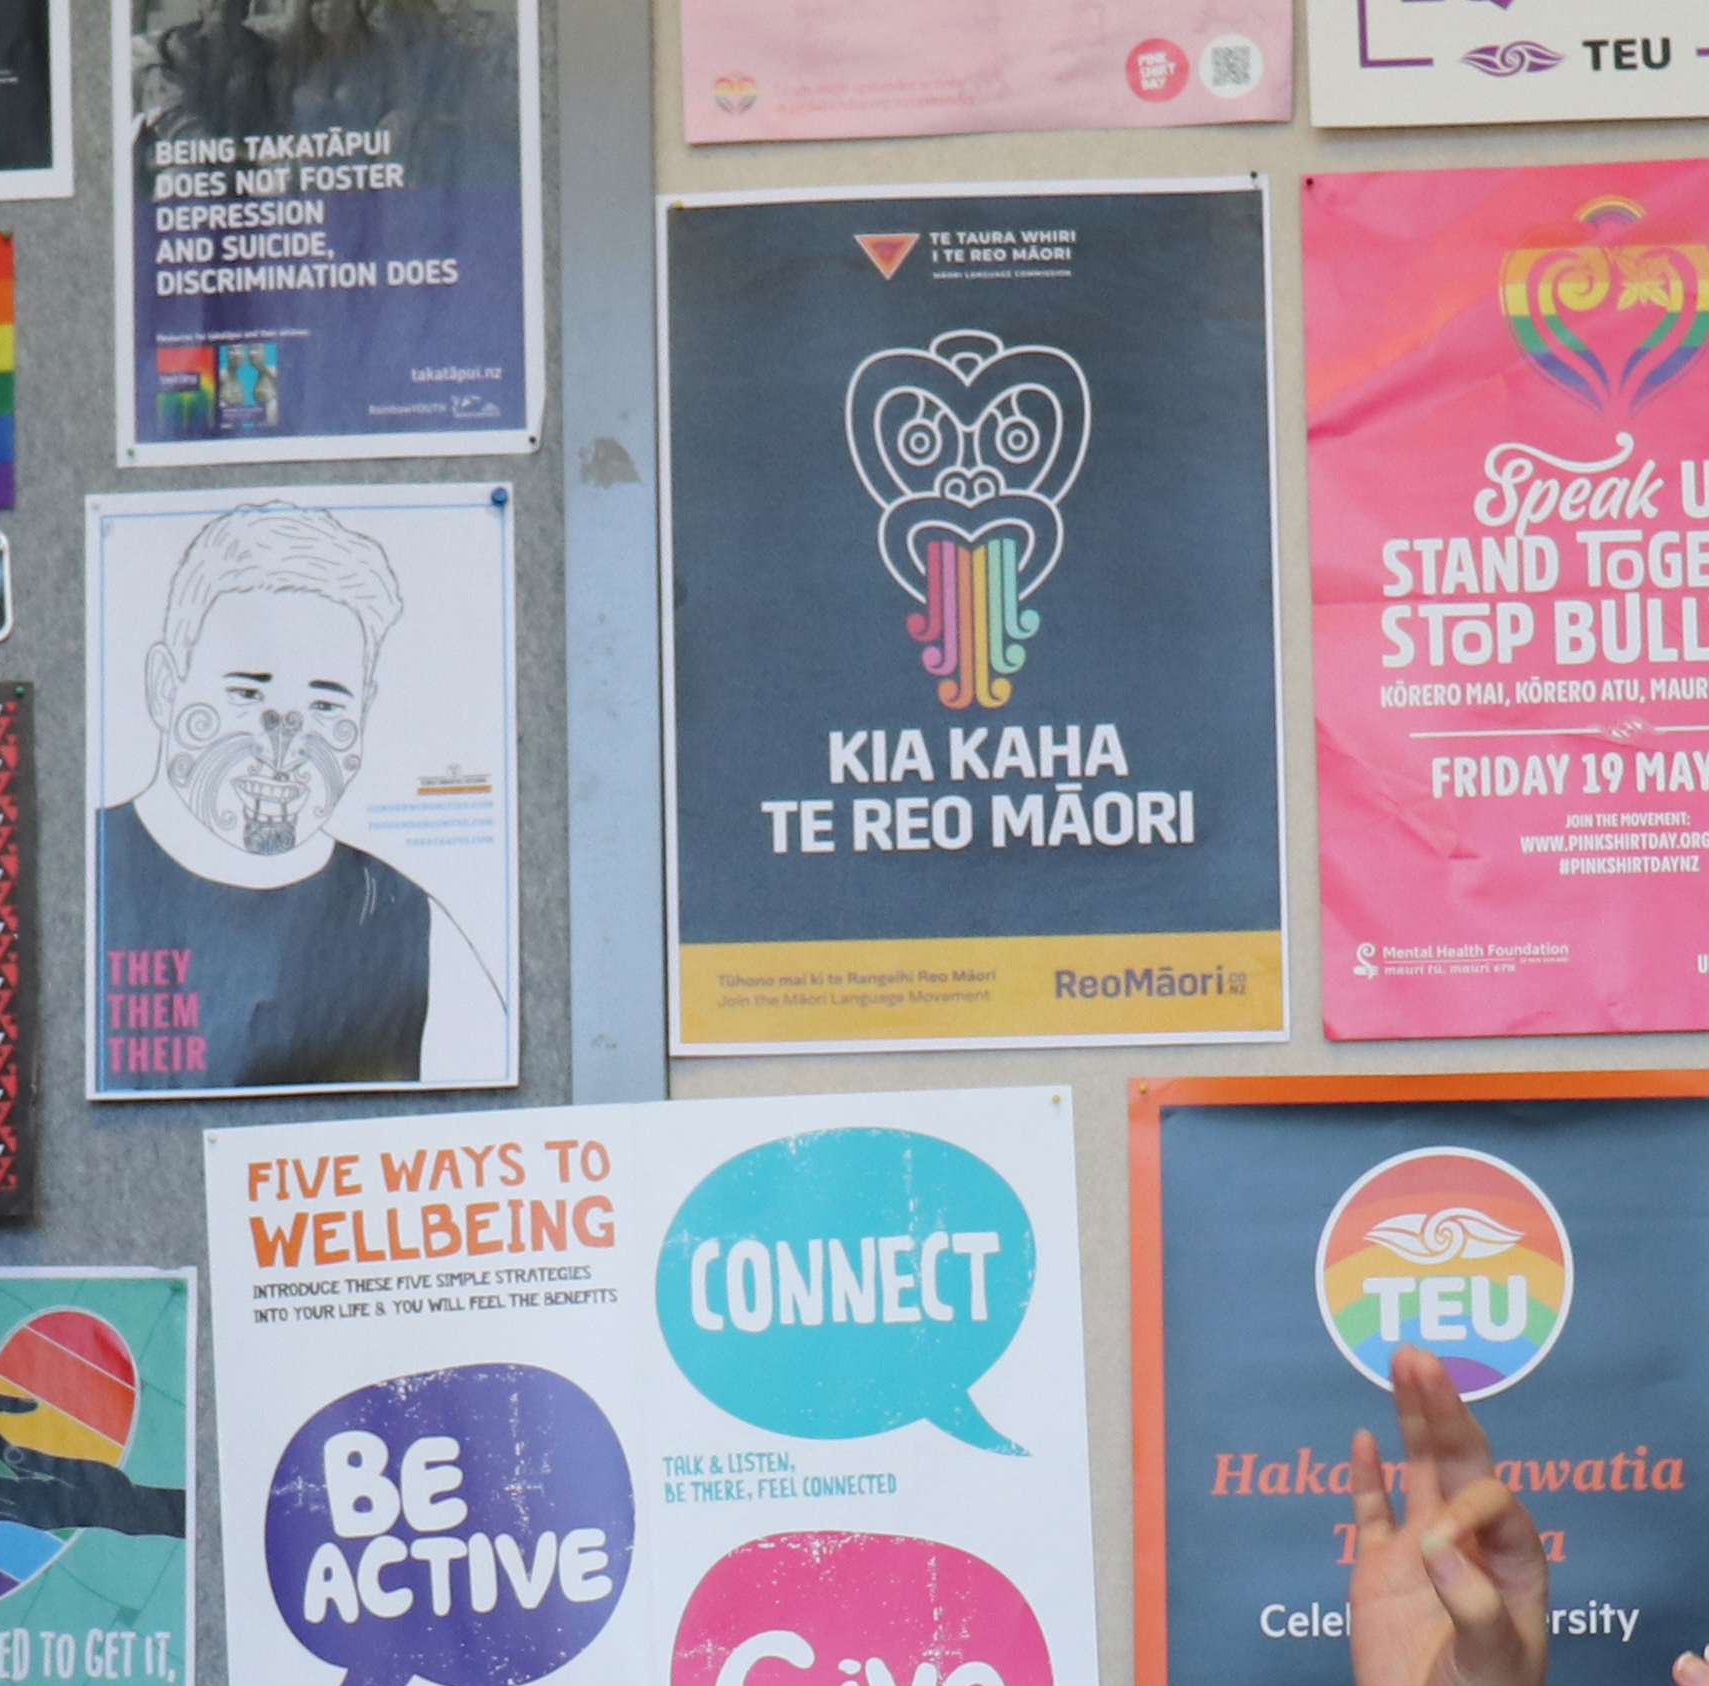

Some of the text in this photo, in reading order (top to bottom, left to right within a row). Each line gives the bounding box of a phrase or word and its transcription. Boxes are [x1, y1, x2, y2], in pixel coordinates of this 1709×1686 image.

[1583, 38, 1672, 71] TEU
[155, 126, 391, 165] BEING TAKATĀPUI
[154, 163, 405, 198] DOES NOT FOSTER
[156, 200, 324, 232] DEPRESSION
[156, 232, 335, 264] AND SUICIDE,
[930, 229, 1076, 245] TE TAURA WHIRI
[932, 245, 1072, 264] I TE REO MĀORI
[156, 259, 459, 295] DISCRIMINATION DOES
[1474, 431, 1665, 539] Speak
[1381, 535, 1560, 597] STAND
[1381, 601, 1534, 669] STOP
[1381, 679, 1461, 709] KŌRERO
[1465, 681, 1511, 707] MAI,
[1515, 675, 1596, 705] KŌRERO
[1601, 678, 1646, 705] ATU,
[828, 723, 1129, 785] KIA KAHA
[1432, 754, 1571, 799] FRIDAY
[1582, 754, 1624, 795] 19
[761, 783, 1195, 854] TE REO MĀORI
[1559, 854, 1700, 876] #PINKSHIRTDAYNZ
[107, 949, 192, 986] THEY
[1054, 966, 1225, 1000] ReoMāori
[107, 993, 199, 1030] THEM
[108, 1036, 207, 1074] THEIR
[248, 1139, 612, 1202] FIVE WAYS TO
[249, 1195, 616, 1268] WELLBEING
[253, 1265, 592, 1300] INTRODUCE THESE FIVE SIMPLE STRATEGIES
[690, 1230, 1001, 1334] CONNECT
[1362, 1274, 1528, 1343] TEU
[323, 1430, 468, 1538] BE
[664, 1473, 897, 1503] BE THERE, FEEL CONNECTED
[304, 1528, 613, 1624] ACTIVE
[40, 1630, 77, 1679] TO
[84, 1628, 137, 1680] GET
[144, 1631, 176, 1684] IT,
